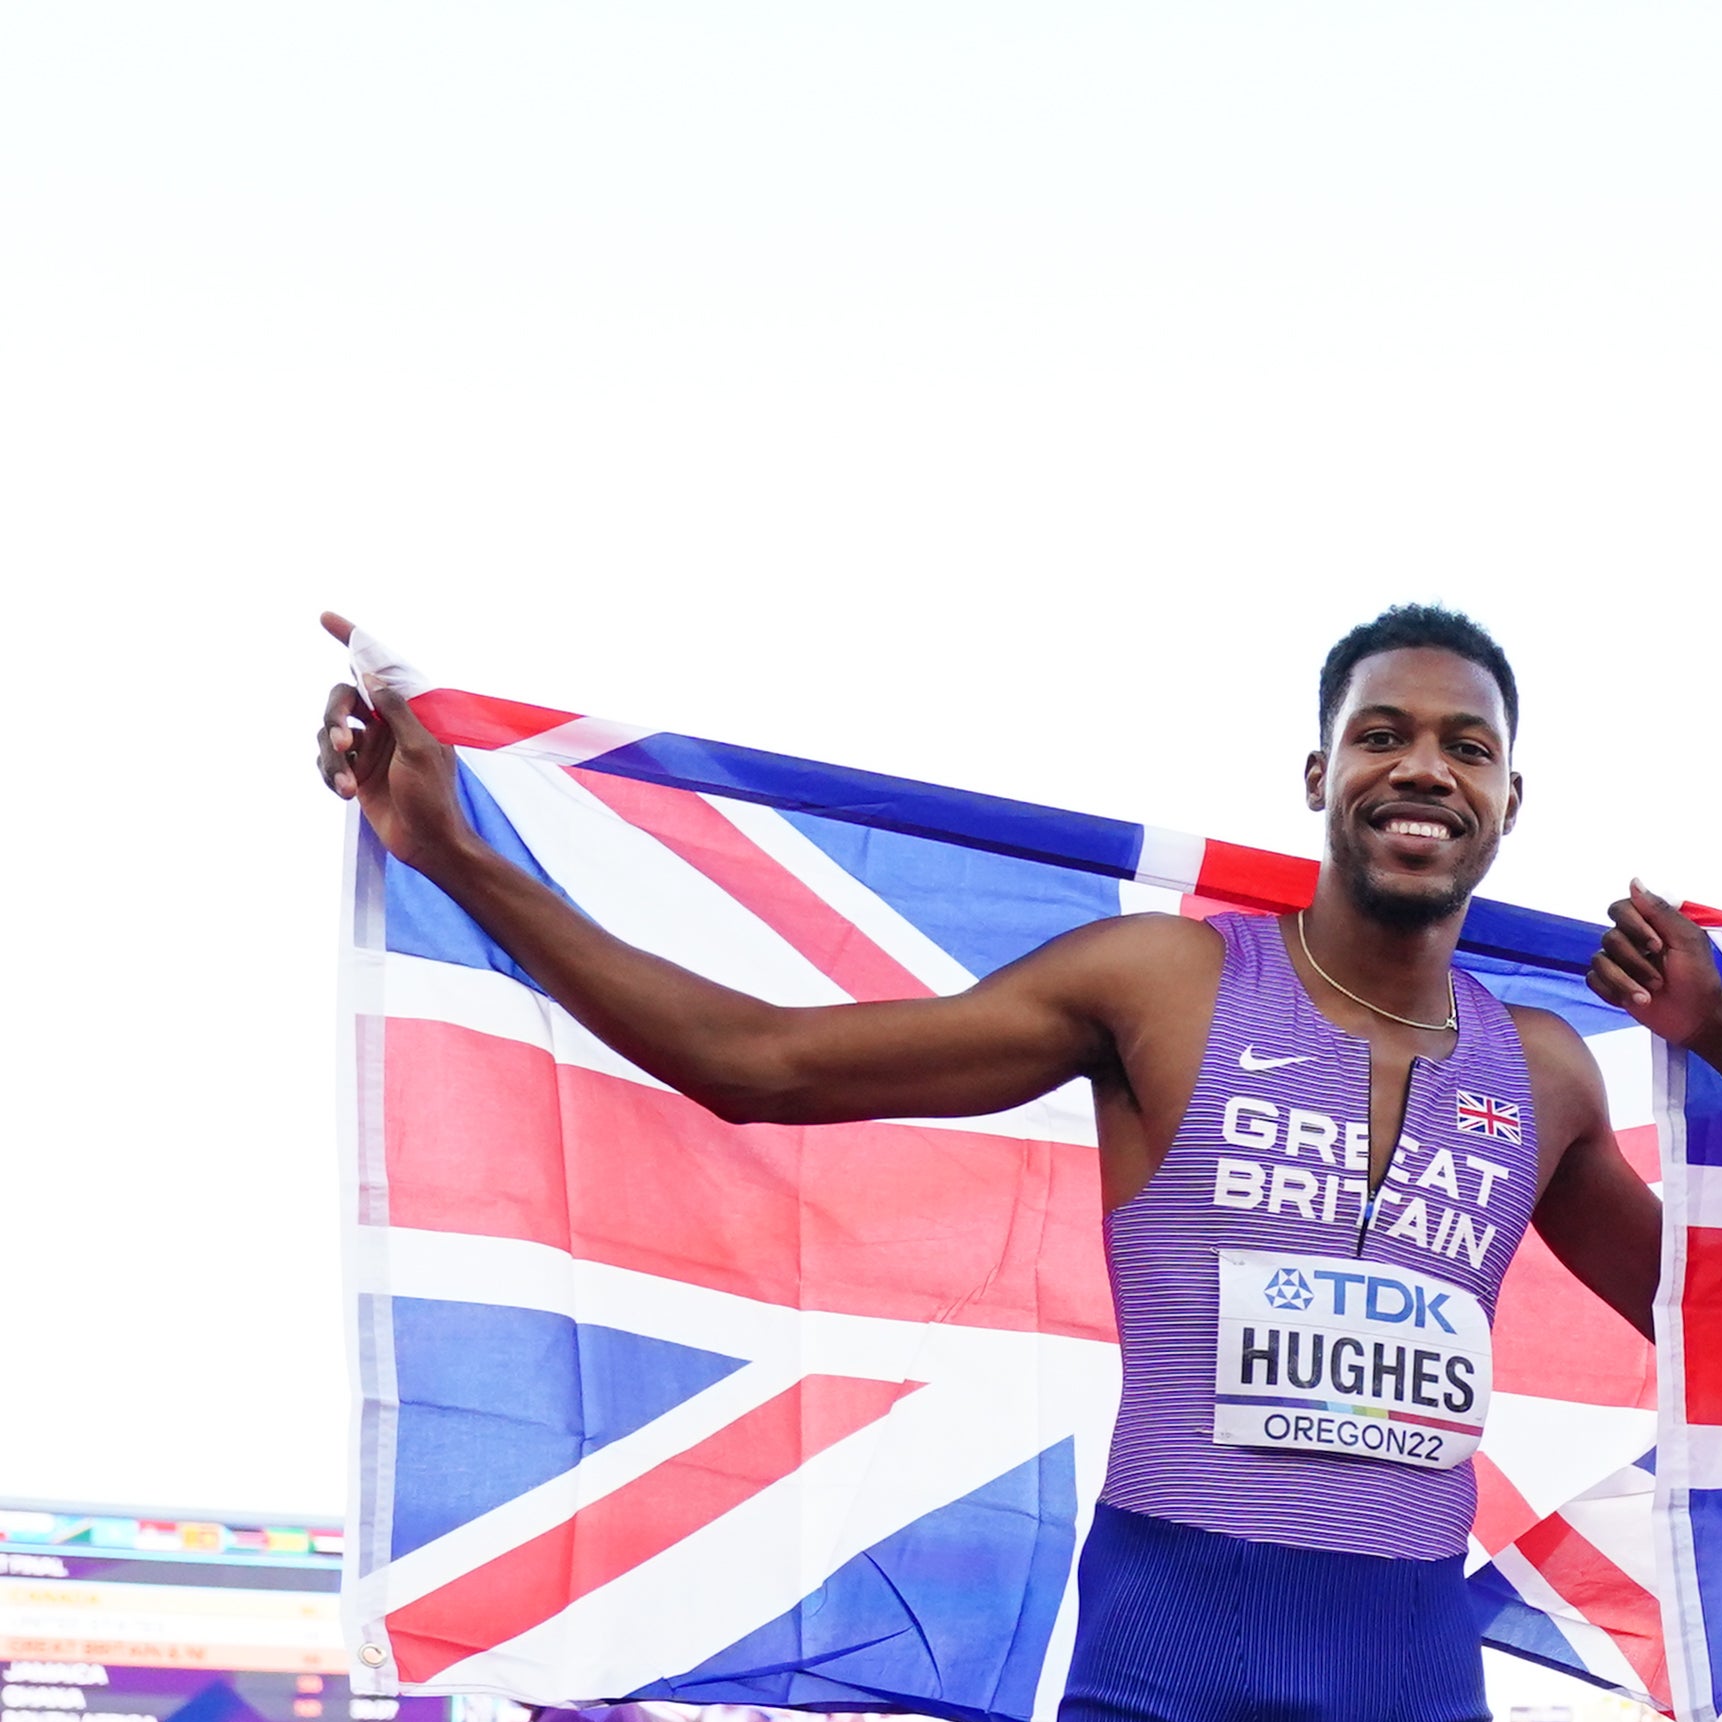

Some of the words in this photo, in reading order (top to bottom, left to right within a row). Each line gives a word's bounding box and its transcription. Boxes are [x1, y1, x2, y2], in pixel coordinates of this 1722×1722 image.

[1222, 1096, 1509, 1208] GREAT
[1212, 1159, 1497, 1270] BRITAIN
[1314, 1270, 1458, 1335] TDK
[1240, 1327, 1475, 1414] HUGHES
[1264, 1413, 1444, 1461] OREGON22
